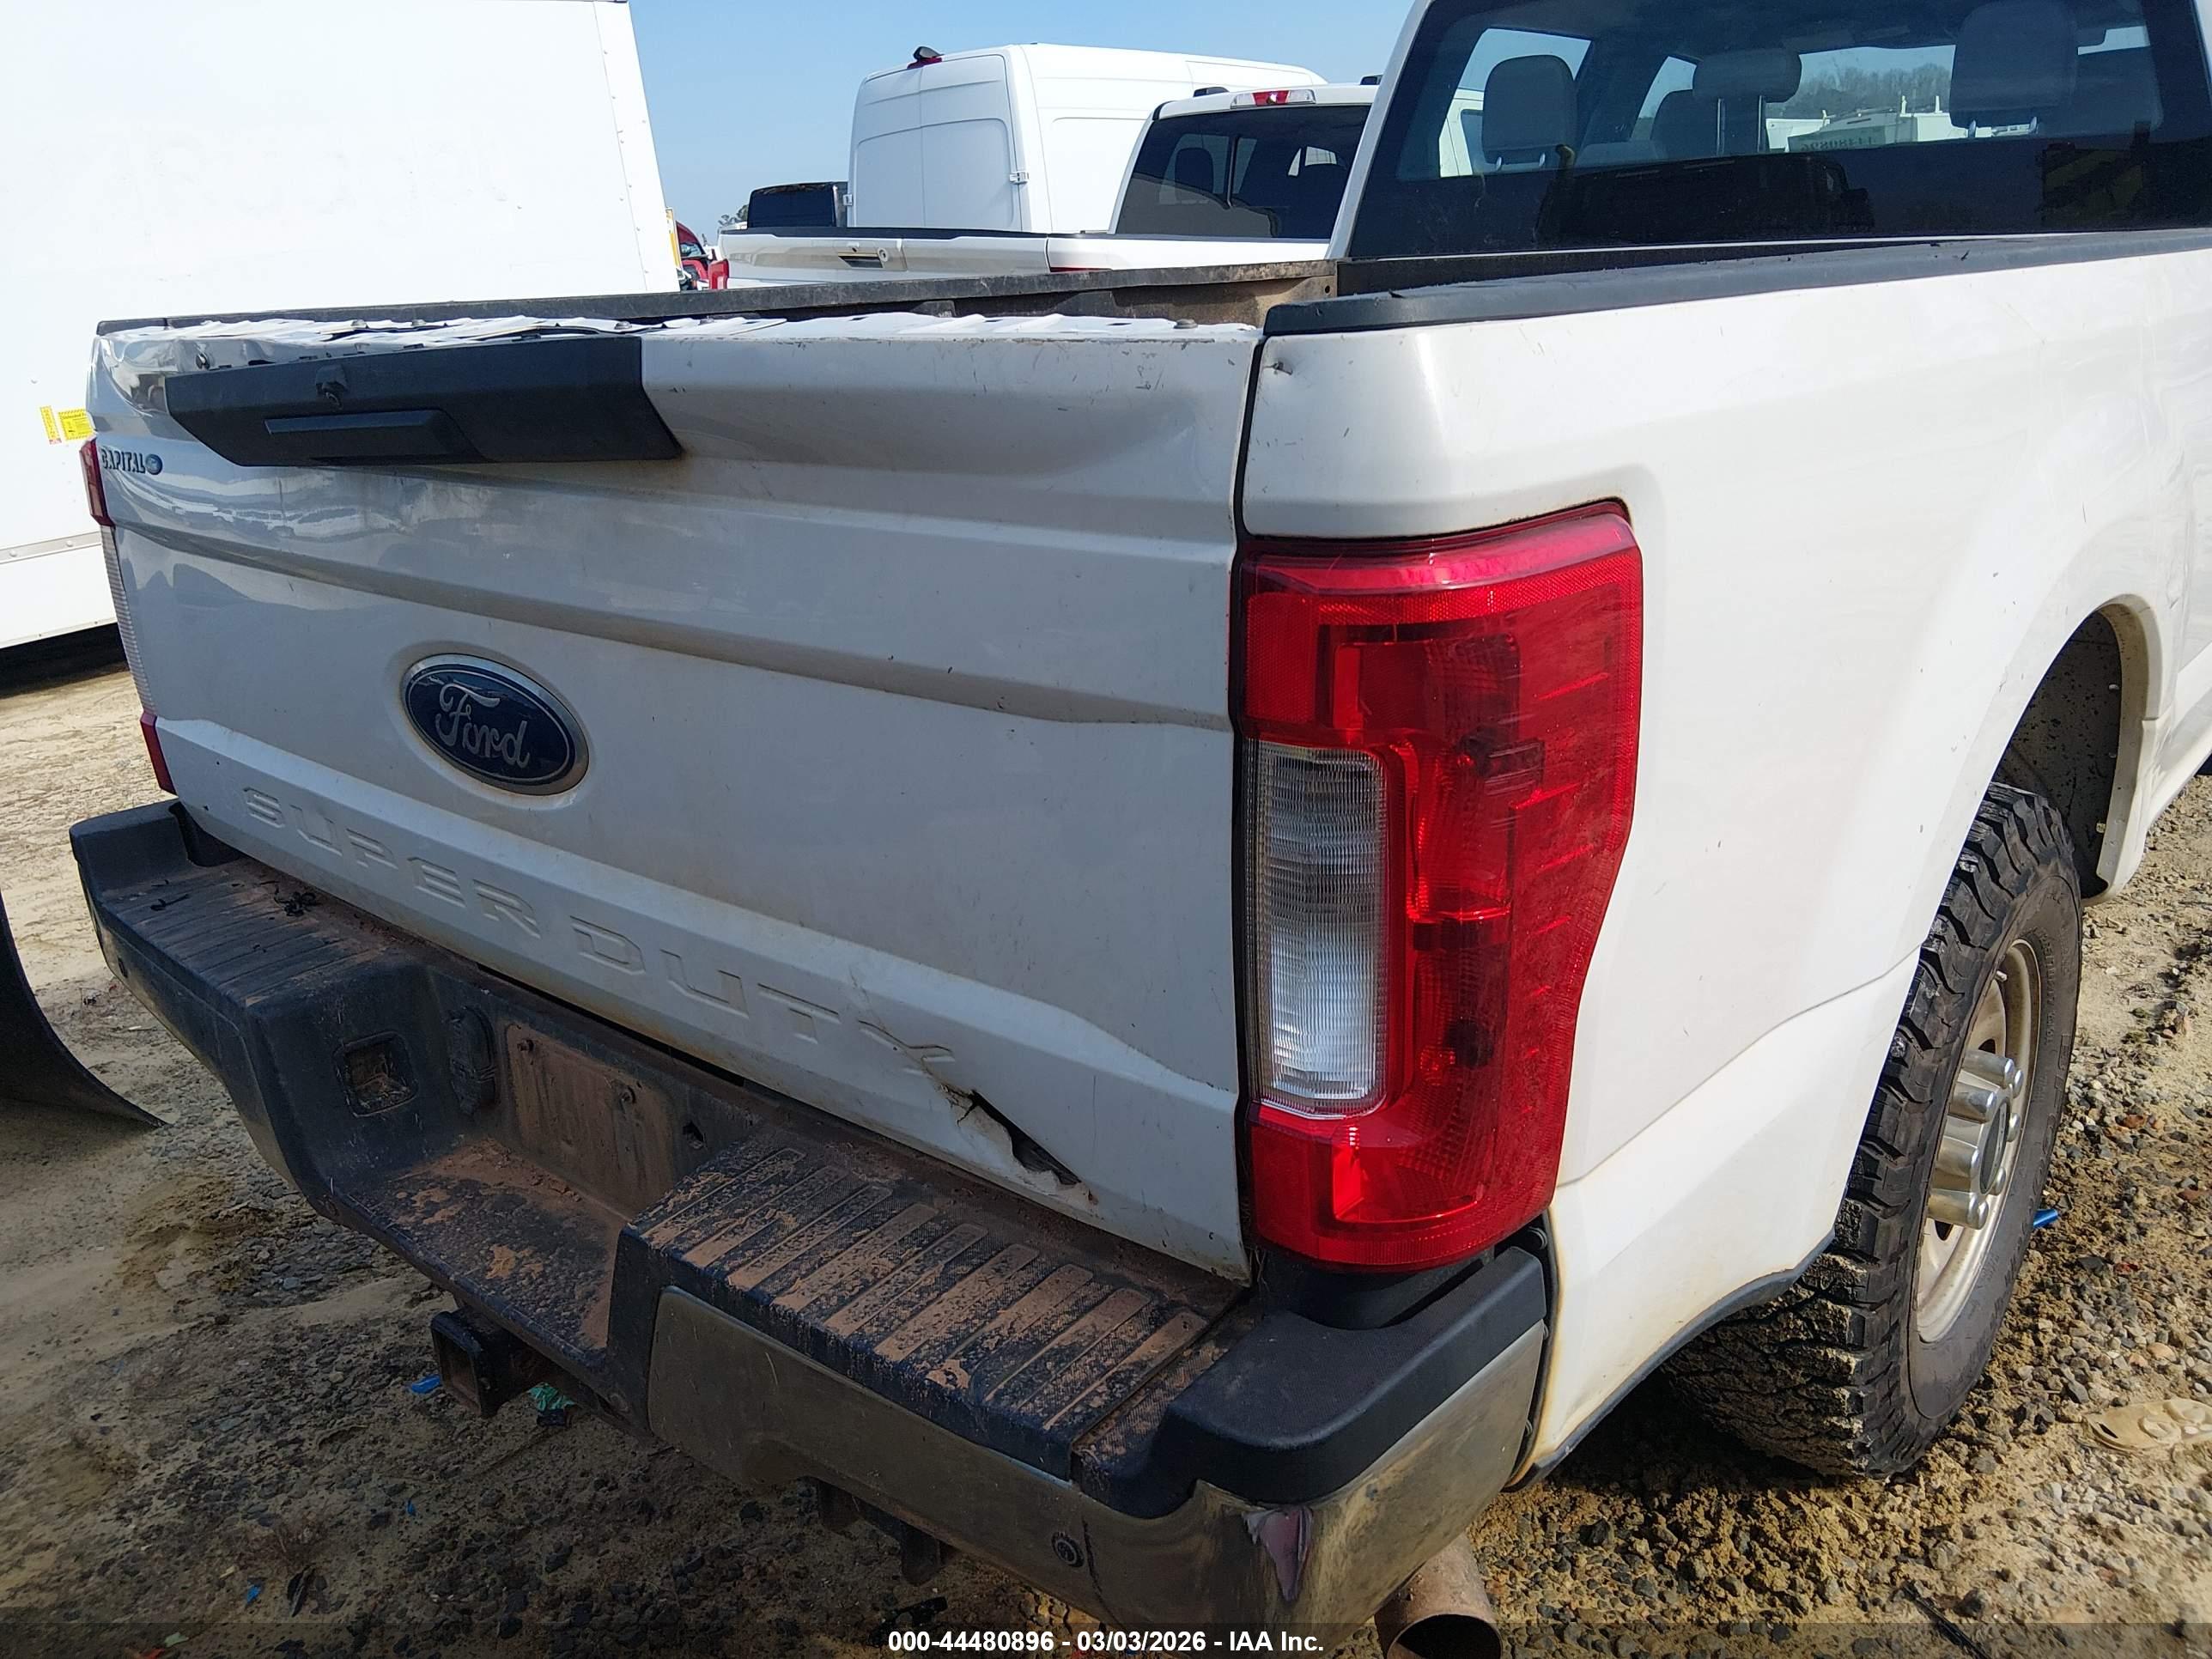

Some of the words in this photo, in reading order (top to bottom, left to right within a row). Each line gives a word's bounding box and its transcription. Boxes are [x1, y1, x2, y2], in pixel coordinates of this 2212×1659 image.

[100, 449, 146, 474] CAPITAL
[435, 683, 531, 769] Ford
[243, 787, 541, 939] SUPER
[570, 915, 956, 1076] DUTY
